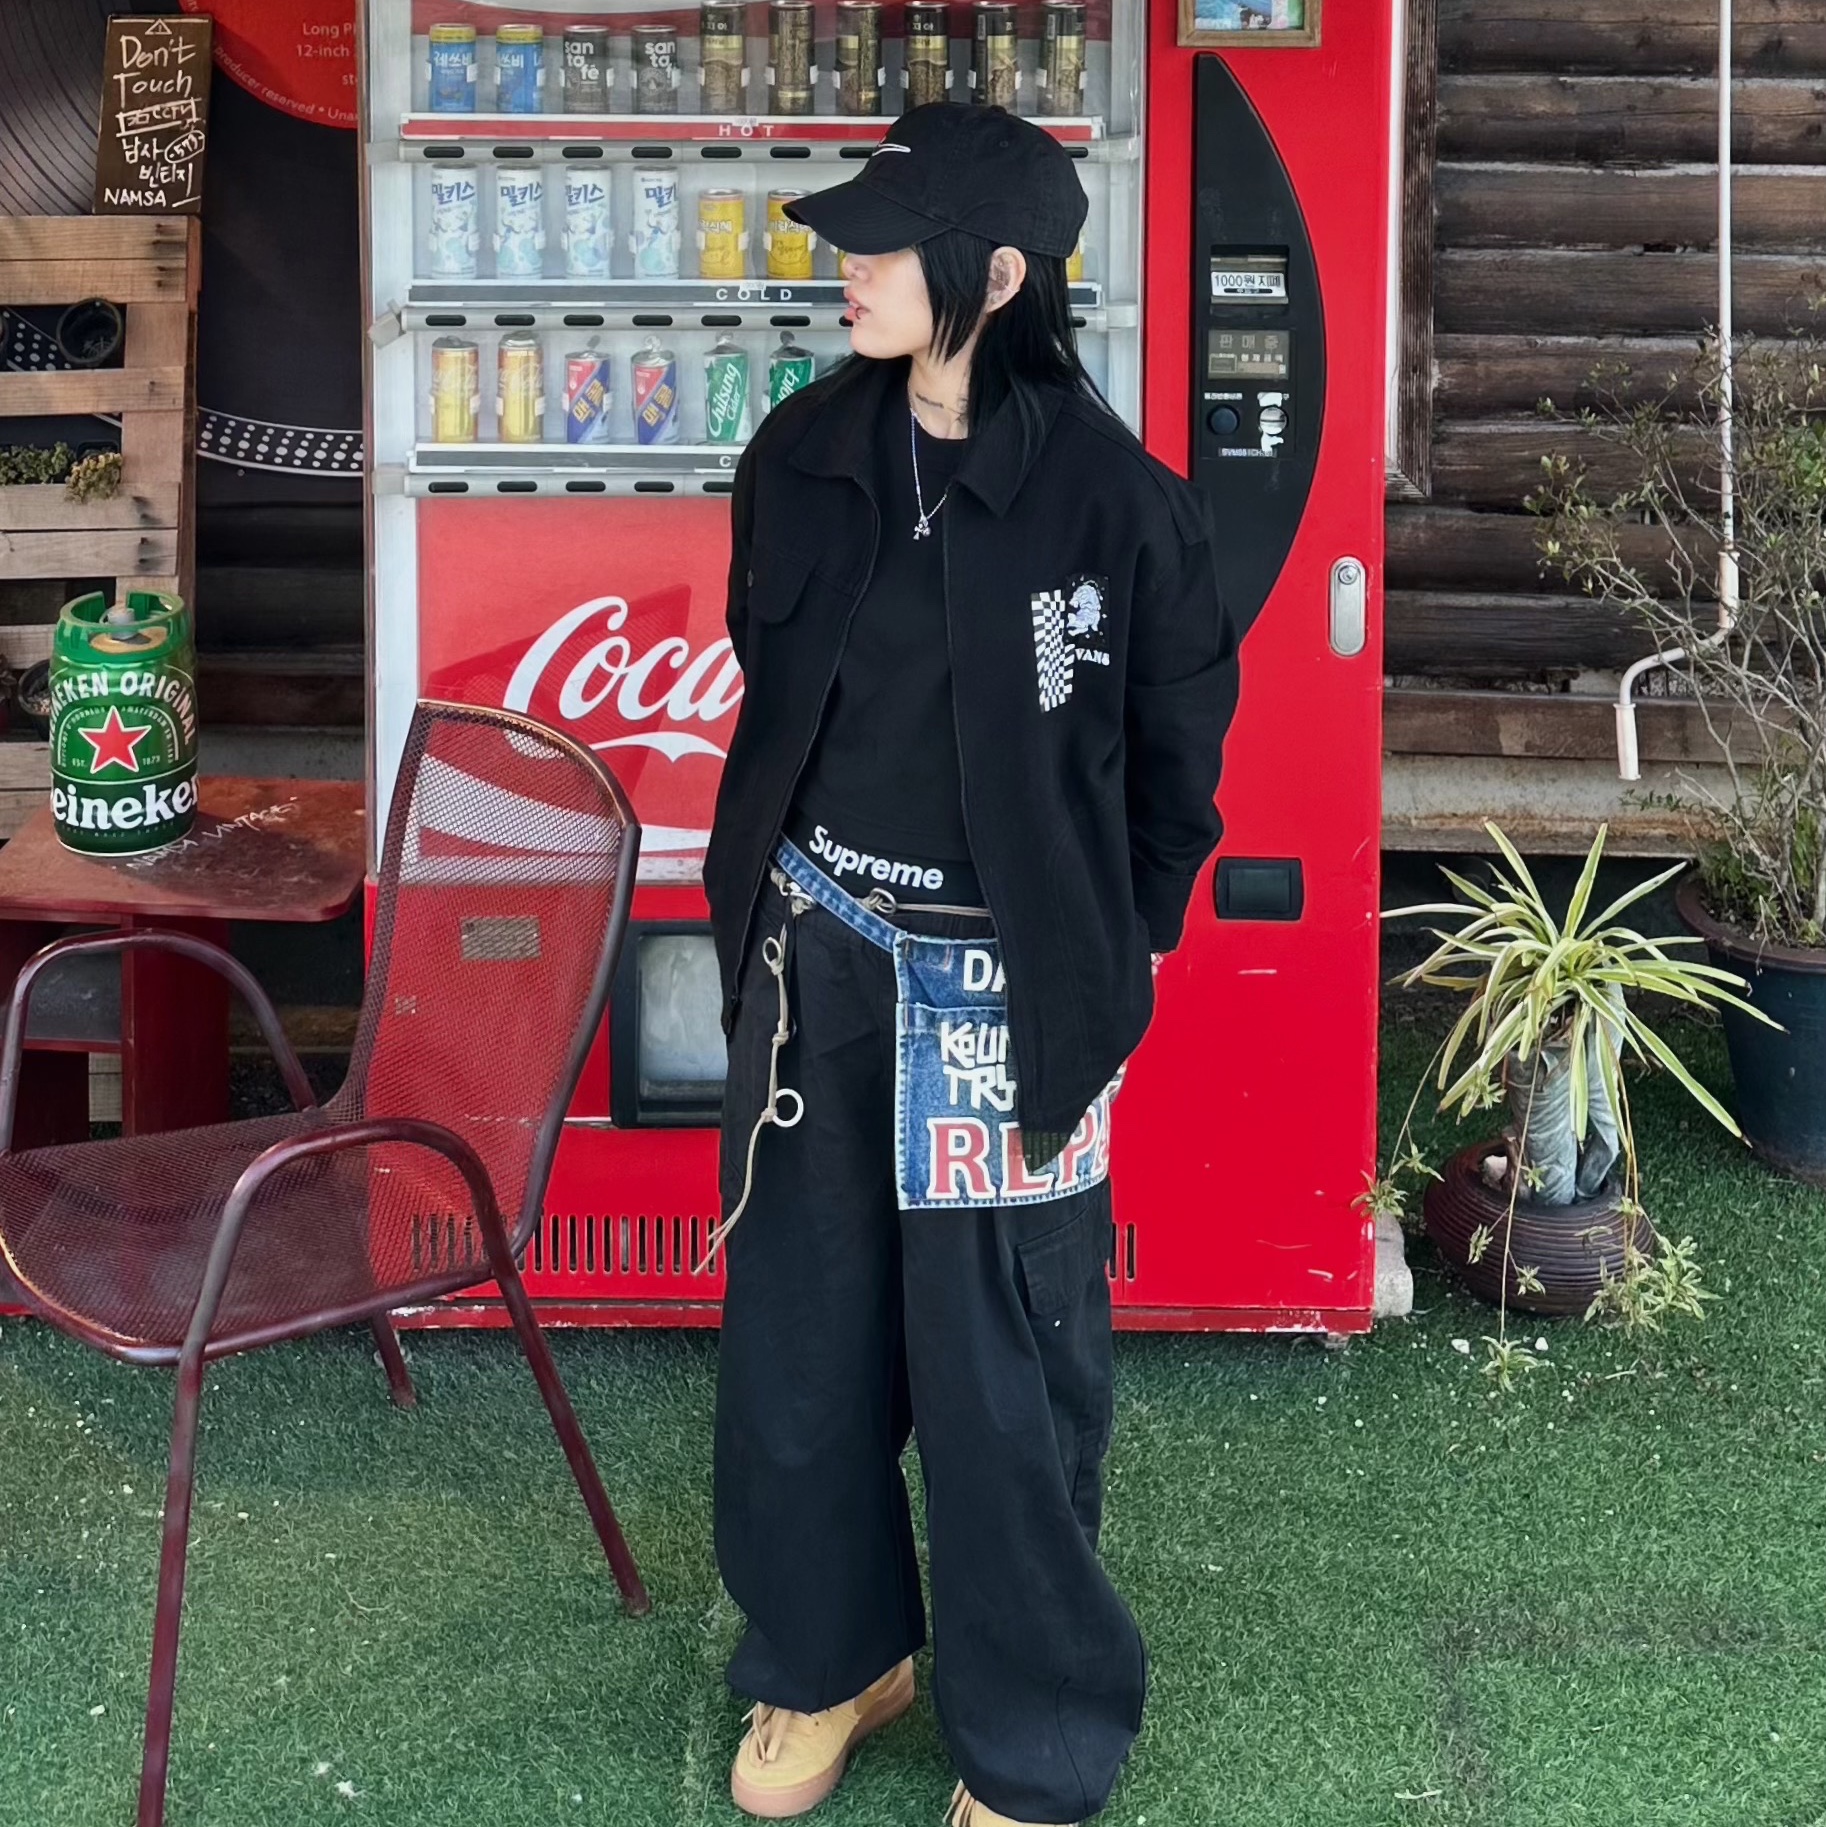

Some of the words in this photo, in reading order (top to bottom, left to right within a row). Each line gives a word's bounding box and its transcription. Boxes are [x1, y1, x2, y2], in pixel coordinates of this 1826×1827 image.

[303, 22, 339, 38] Long
[120, 35, 196, 69] Don't
[297, 44, 350, 57] 12-inch
[565, 41, 594, 54] san
[645, 41, 675, 55] san
[113, 70, 192, 108] Touch
[212, 46, 262, 89] producer
[261, 86, 317, 115] reserved
[342, 73, 358, 86] st
[719, 125, 774, 137] HOT
[139, 162, 193, 197] 빈티지
[104, 187, 166, 207] NAMSA
[432, 181, 476, 205] 밀키스
[500, 182, 544, 207] 밀키스
[1215, 274, 1255, 288] 1000원
[716, 288, 793, 301] COLD
[708, 362, 742, 438] Chilsung
[120, 670, 196, 746] ORIGINAL
[808, 824, 944, 891] Supreme
